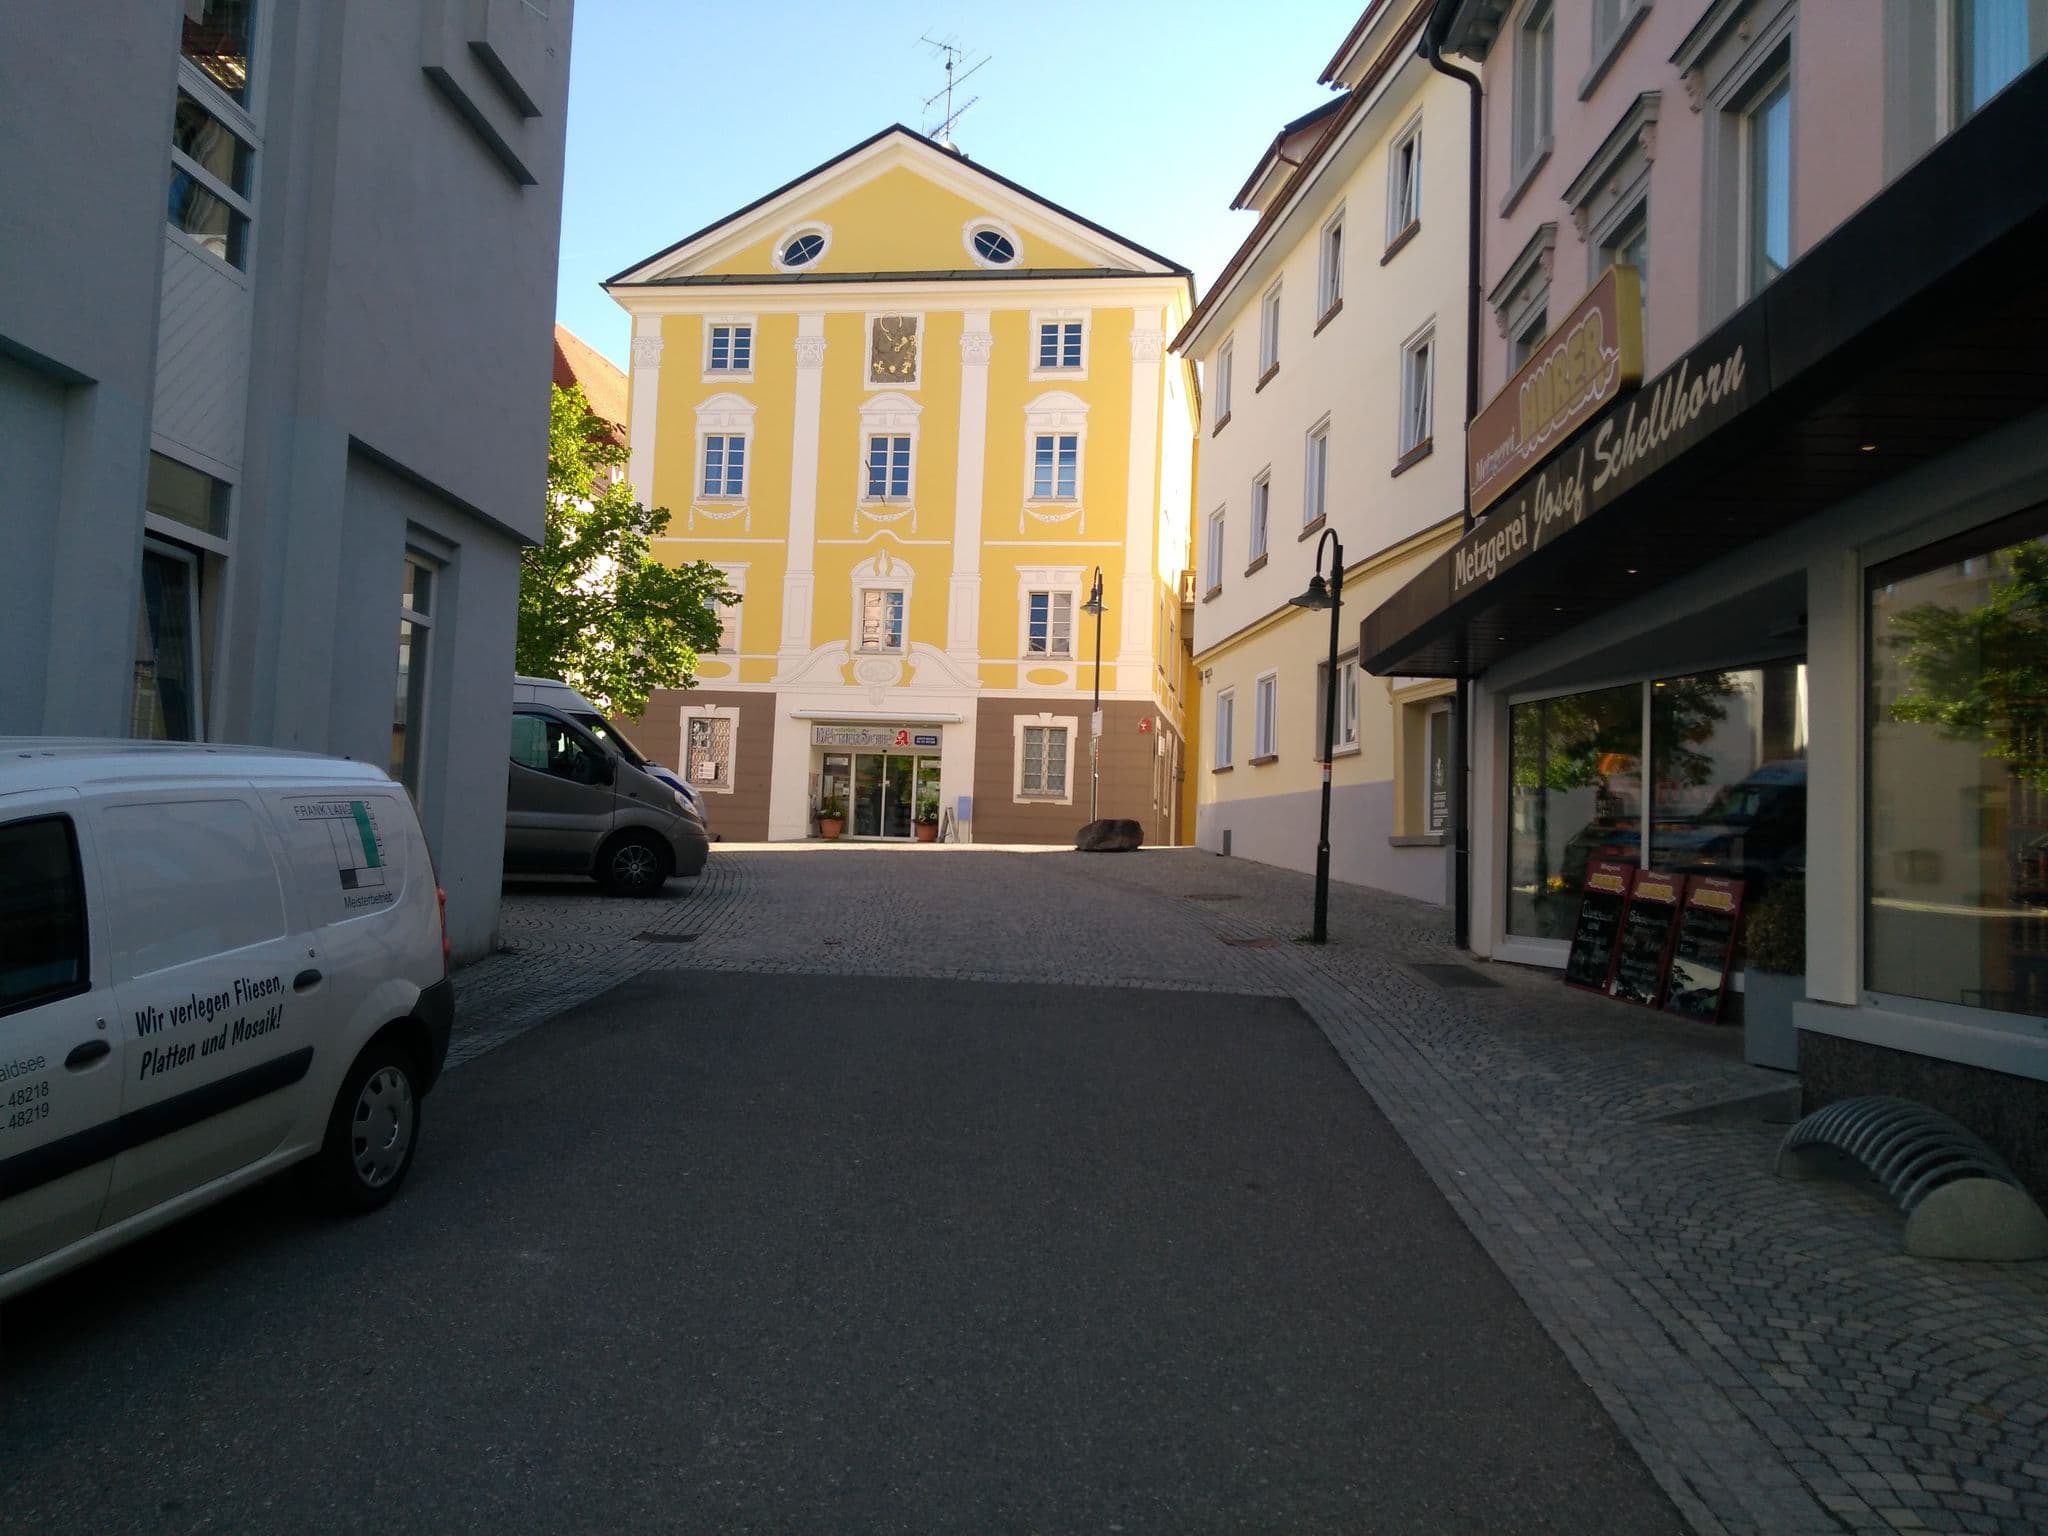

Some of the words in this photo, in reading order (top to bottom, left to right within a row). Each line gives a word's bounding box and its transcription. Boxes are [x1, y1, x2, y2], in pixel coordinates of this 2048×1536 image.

[1455, 502, 1528, 591] Metzgerei
[1533, 448, 1586, 552] Josef
[1593, 345, 1745, 493] Schellhorn
[294, 805, 326, 817] FRANK
[328, 803, 353, 816] LANG
[344, 890, 394, 909] Meisterbetrieb
[136, 1006, 164, 1037] Wir
[170, 991, 230, 1026] verlegen
[234, 975, 285, 1005] Fliesen,
[139, 1043, 196, 1081] Platten
[201, 1023, 228, 1056] und
[231, 1003, 283, 1046] Mosaik!
[8, 1081, 49, 1107] 48218
[8, 1102, 49, 1129] 48219
